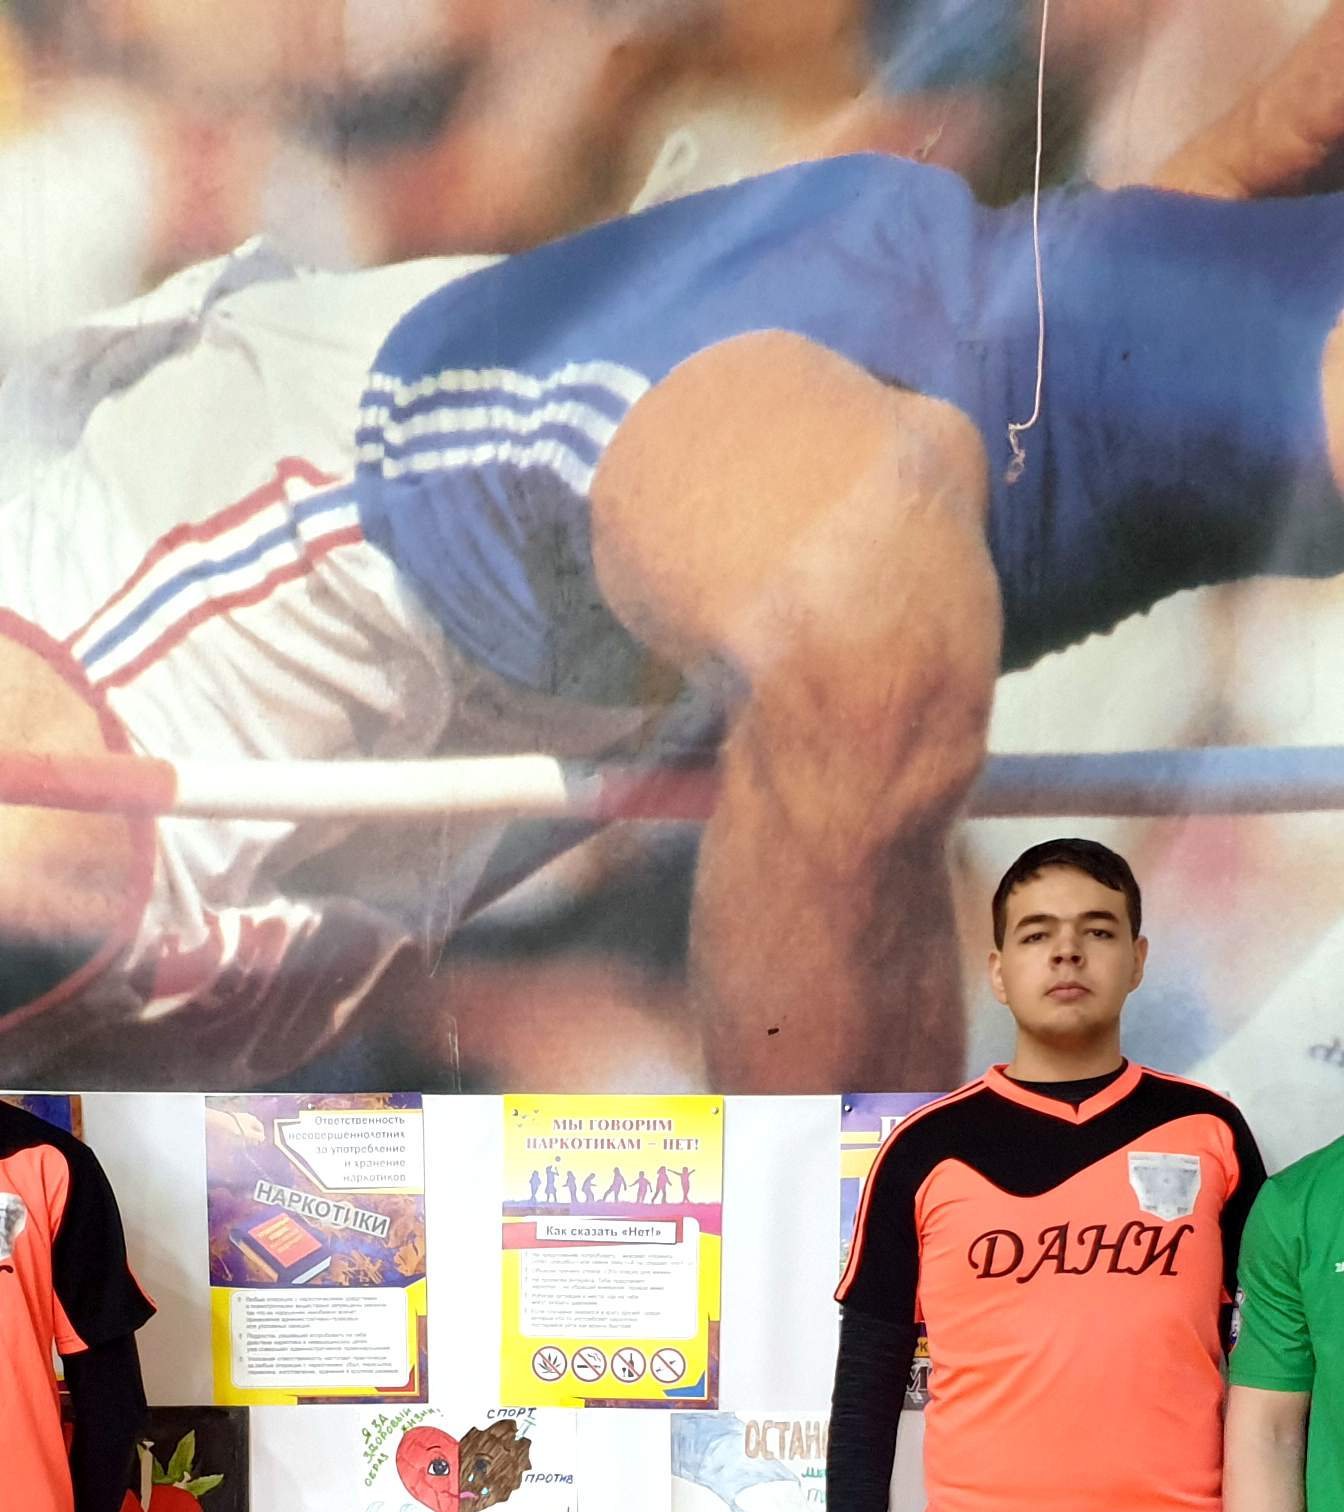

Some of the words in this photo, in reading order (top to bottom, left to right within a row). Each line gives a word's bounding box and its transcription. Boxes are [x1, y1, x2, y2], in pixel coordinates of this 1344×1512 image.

[553, 1119, 582, 1131] МЫ
[590, 1119, 672, 1131] ГОВОРИМ
[527, 1138, 641, 1150] НАРКОТИКАМ
[663, 1138, 699, 1151] НЕТ!
[257, 1183, 389, 1236] НАРКОТИКИ
[546, 1226, 567, 1236] Как
[571, 1227, 618, 1237] сказать
[968, 1219, 1194, 1284] ДАНИ
[487, 1406, 537, 1420] СПОРТ
[361, 1427, 372, 1445] Я
[371, 1413, 389, 1434] ЗА
[364, 1453, 389, 1487] ОБРАЗ
[525, 1472, 574, 1485] ПРОТИВ
